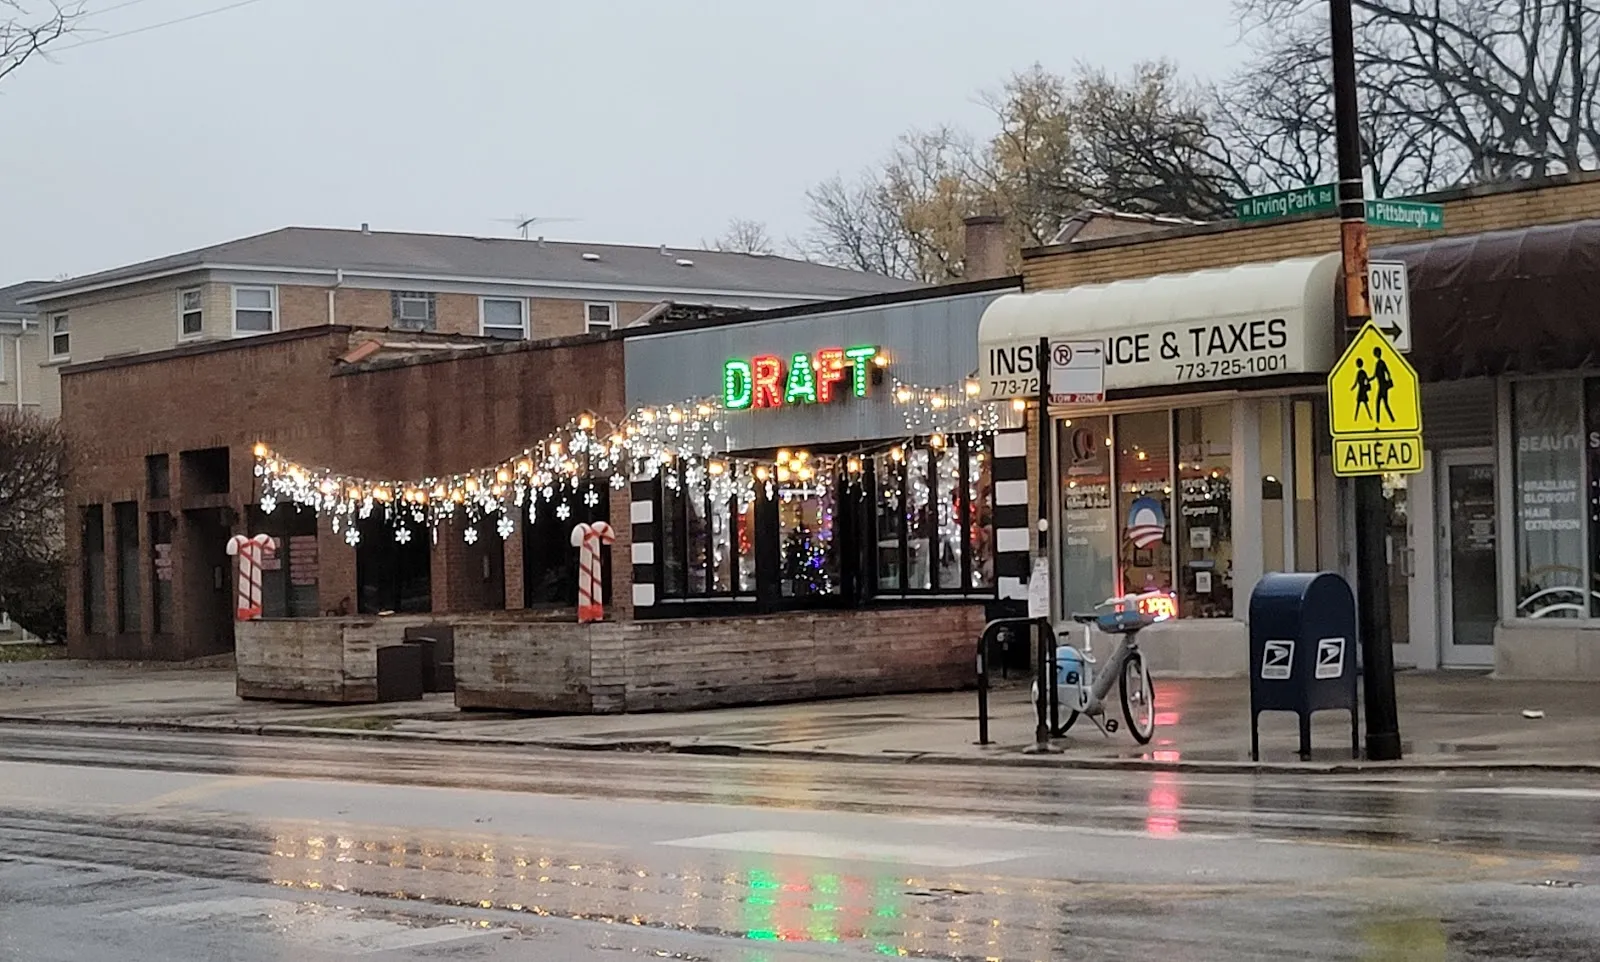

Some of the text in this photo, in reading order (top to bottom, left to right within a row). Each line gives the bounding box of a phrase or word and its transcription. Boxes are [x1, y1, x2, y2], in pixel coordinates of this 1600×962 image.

[1252, 197, 1287, 216] Irving
[1287, 190, 1316, 209] Park
[1319, 191, 1332, 202] Rd
[1376, 203, 1428, 228] Pittsburgh
[1371, 270, 1402, 290] ONE
[1372, 295, 1403, 315] WAY
[1160, 331, 1181, 360] &
[1189, 318, 1287, 357] TAXES
[723, 345, 877, 409] DRAFT
[1175, 354, 1287, 380] 773-725-1001
[1345, 442, 1413, 467] AHEAD
[1519, 434, 1579, 452] BEAUTY
[1524, 492, 1577, 504] BLOWOUT
[1524, 507, 1551, 519] HAIR
